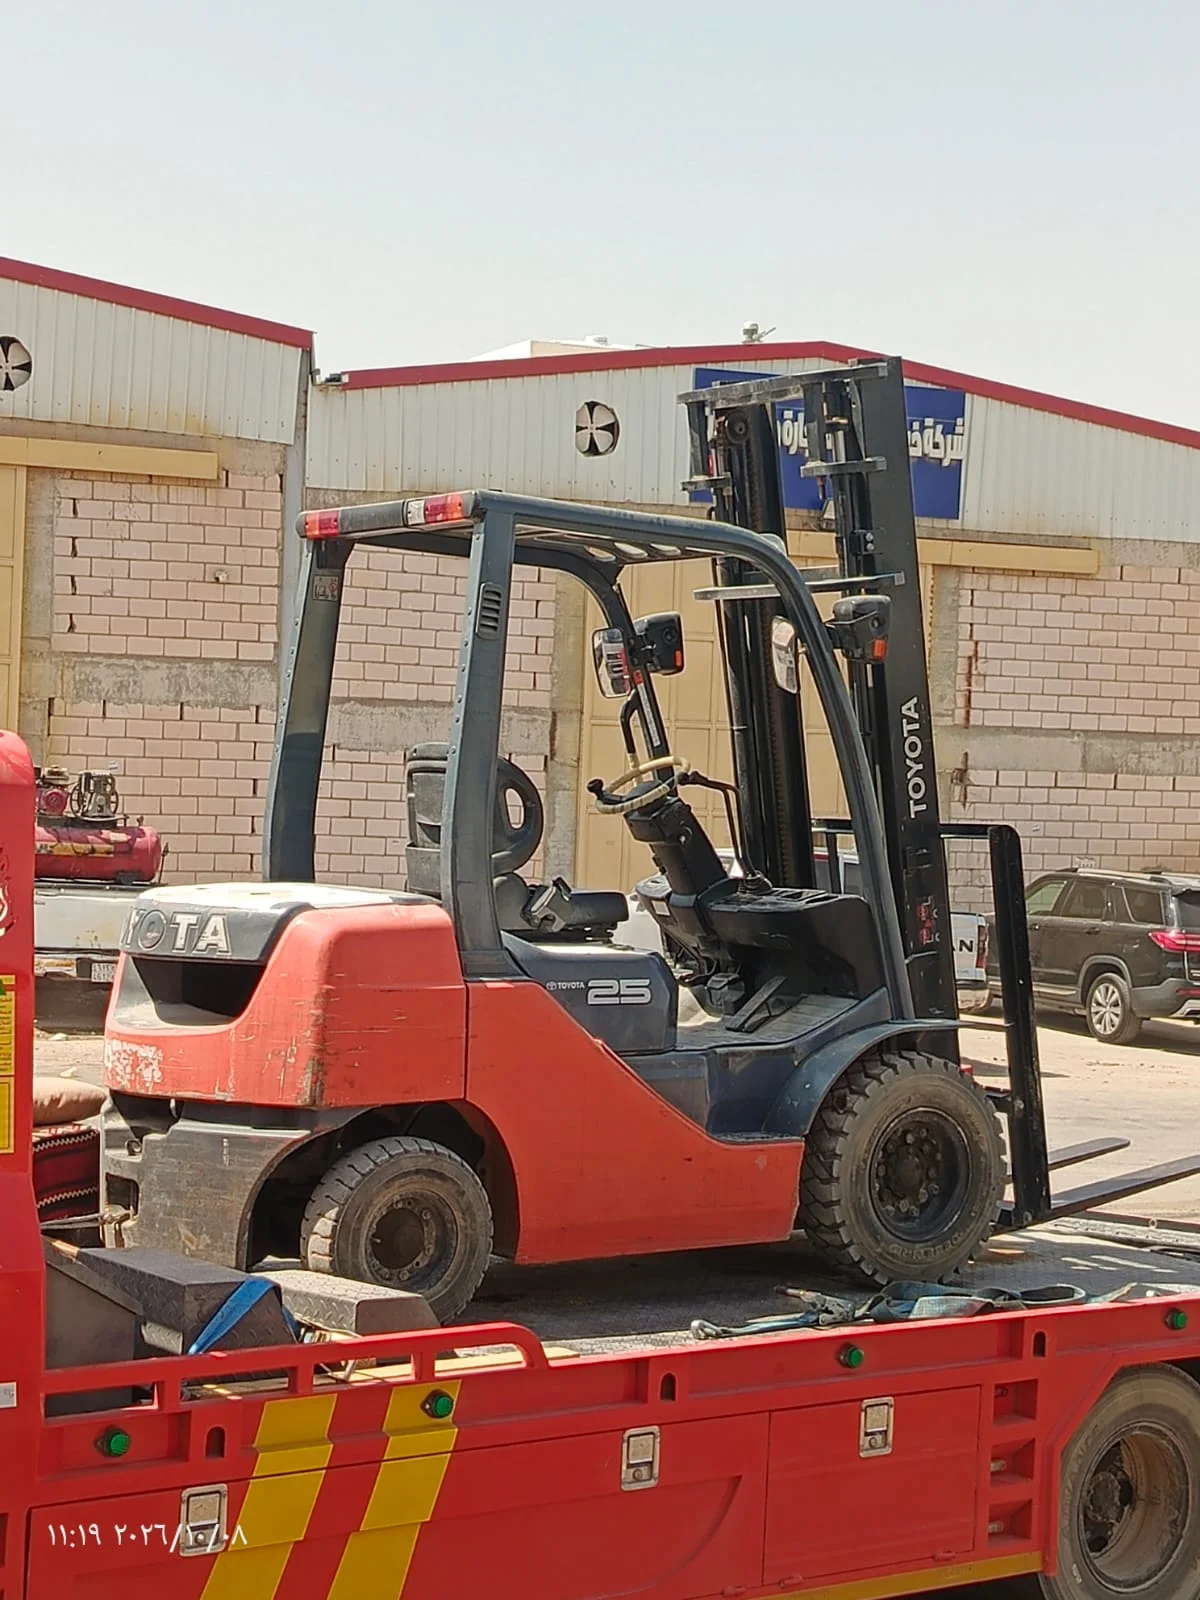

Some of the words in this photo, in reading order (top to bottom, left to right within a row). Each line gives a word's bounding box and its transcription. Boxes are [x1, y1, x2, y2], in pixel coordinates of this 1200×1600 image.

[922, 417, 964, 467] شركة
[901, 697, 928, 818] TOYOTA
[121, 906, 232, 956] YOTA
[557, 981, 586, 990] TOYOTA
[587, 979, 651, 1005] 25
